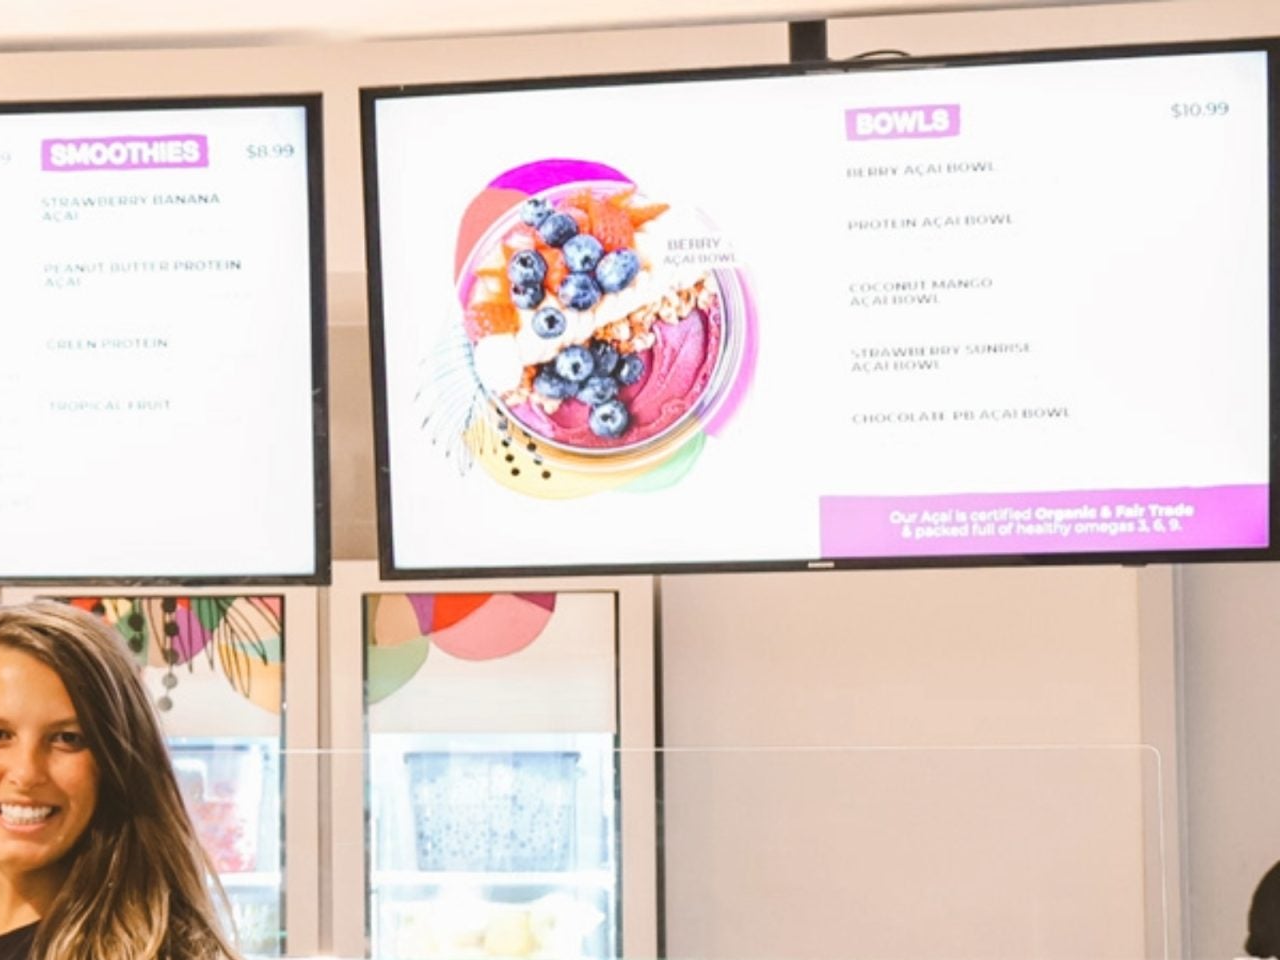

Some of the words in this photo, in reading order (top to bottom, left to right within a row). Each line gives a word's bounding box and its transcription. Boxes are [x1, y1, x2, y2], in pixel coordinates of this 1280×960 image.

[1170, 101, 1230, 119] $10.99
[855, 108, 950, 136] BOWLS
[50, 139, 201, 166] SMOOTHIES
[246, 143, 295, 159] $8.99
[846, 166, 898, 179] BERRY
[946, 160, 994, 173] BOWL
[41, 194, 147, 208] STRAWBERRY
[152, 192, 221, 205] BANANA
[847, 218, 917, 230] PROTEIN
[964, 213, 1014, 226] BOWL
[667, 238, 721, 251] BERRY
[697, 252, 735, 263] BOWL
[43, 261, 104, 274] PEANUT
[110, 260, 169, 273] BUTTER
[174, 258, 242, 271] PROTEIN
[848, 280, 926, 293] COCONUT
[931, 277, 993, 291] MANGO
[892, 293, 940, 305] BOWL
[46, 338, 97, 350] GREEN
[102, 337, 169, 349] PROTEIN
[851, 345, 960, 358] STRAWBERRY
[965, 342, 1032, 355] SUNRISE
[893, 359, 940, 371] BOWL
[852, 411, 944, 424] CHOCOLATE
[953, 409, 975, 422] PB
[1022, 406, 1071, 419] BOWL
[889, 509, 917, 524] Our
[955, 509, 967, 523] is
[970, 507, 1032, 522] certified
[1035, 505, 1096, 522] Organic
[1100, 505, 1112, 519] &
[1115, 503, 1145, 518] Fair
[1148, 503, 1195, 517] Trade
[901, 525, 912, 538] &
[915, 523, 969, 540] packed
[972, 522, 995, 537] full
[997, 522, 1013, 536] of
[1016, 520, 1071, 537] healthy
[1074, 521, 1135, 536] omegas
